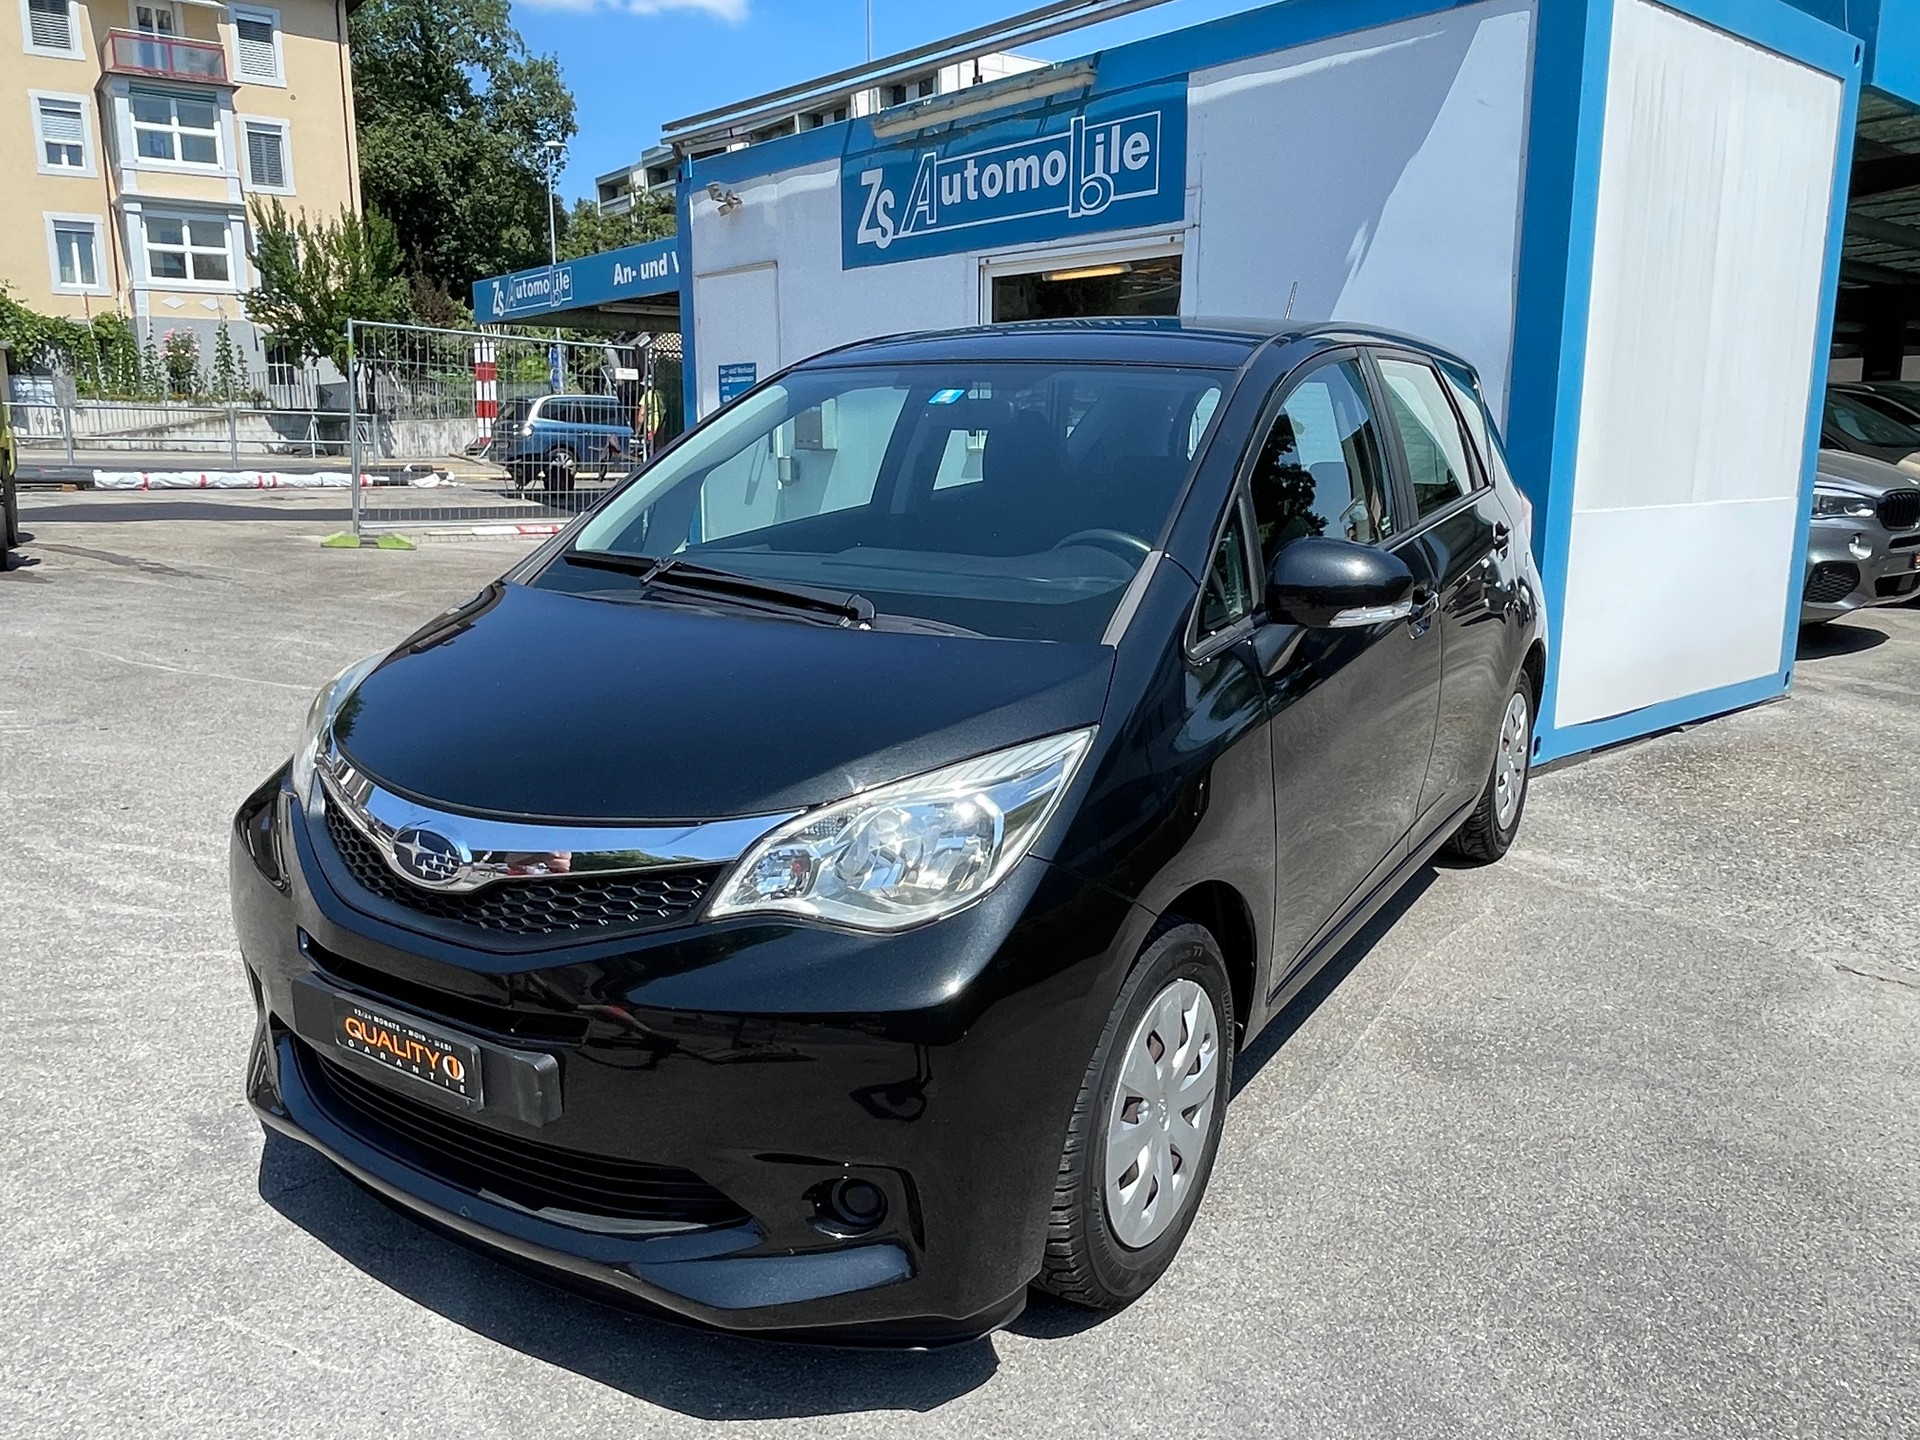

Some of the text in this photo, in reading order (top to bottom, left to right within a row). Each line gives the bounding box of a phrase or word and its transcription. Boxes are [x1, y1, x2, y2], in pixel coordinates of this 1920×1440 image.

[900, 116, 1151, 234] Automobile
[504, 265, 571, 310] Automobile
[613, 263, 637, 286] An-
[641, 253, 668, 280] und
[345, 1017, 440, 1070] QUALITY
